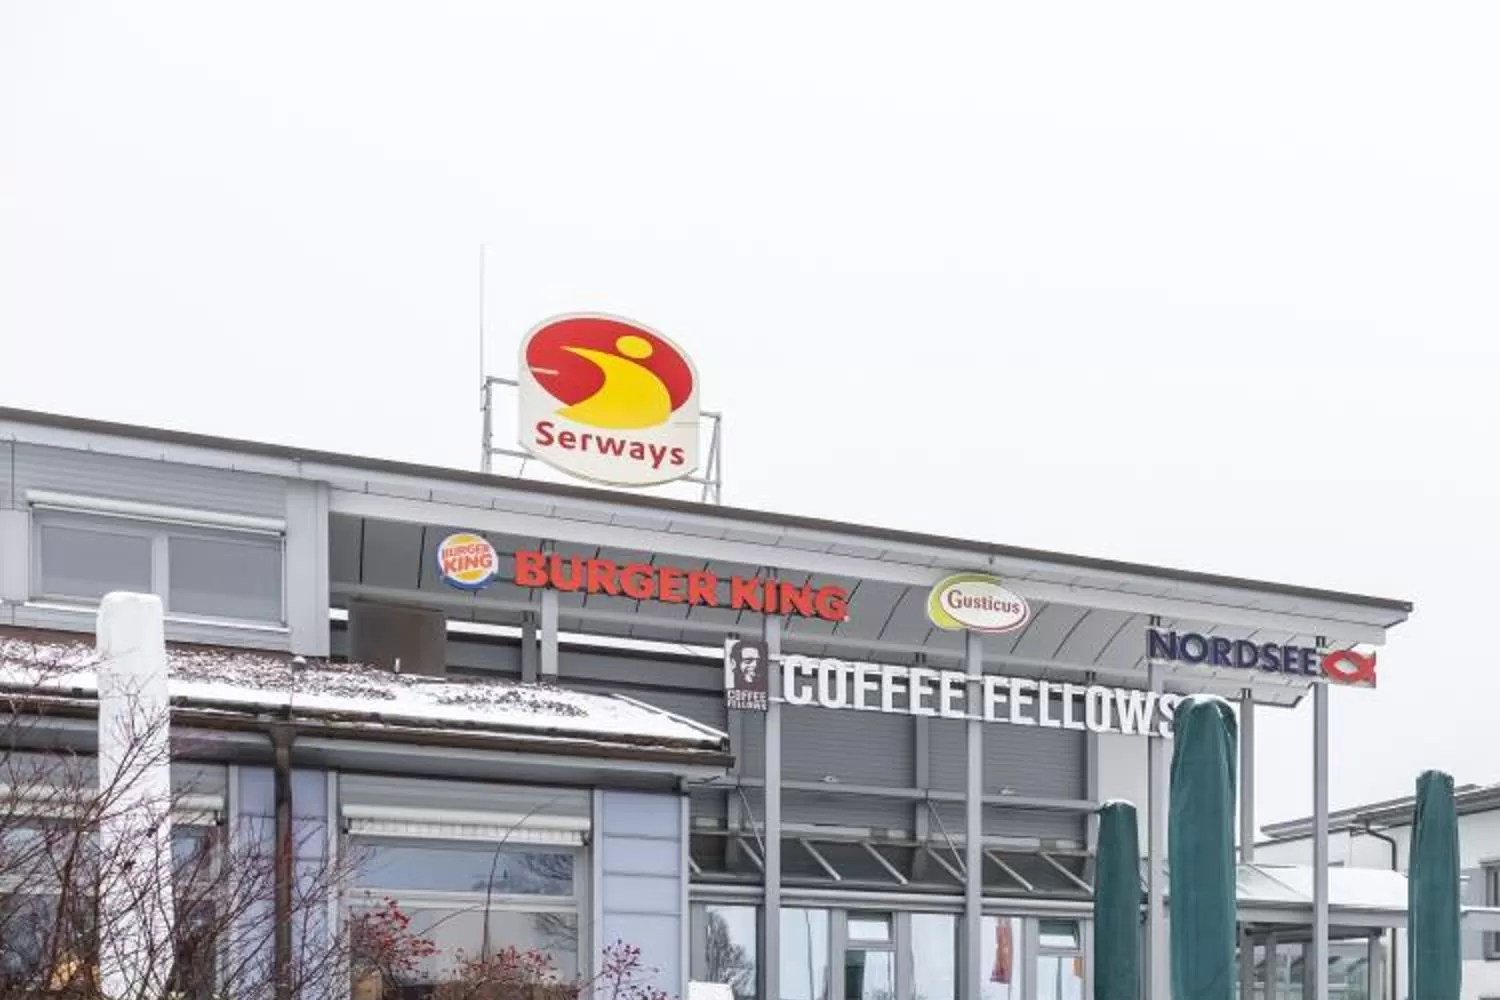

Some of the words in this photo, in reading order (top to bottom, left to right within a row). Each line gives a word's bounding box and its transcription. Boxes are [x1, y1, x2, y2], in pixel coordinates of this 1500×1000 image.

[535, 421, 685, 469] Serways
[441, 543, 492, 558] BURGER
[443, 552, 493, 575] KING
[513, 551, 718, 607] BURGER
[730, 576, 848, 621] KING
[947, 589, 1021, 614] Gusticus
[1146, 628, 1317, 676] NORDSEE
[727, 689, 767, 701] COFFEE
[727, 699, 767, 710] FELLOWS
[782, 654, 967, 719] COFFEE
[984, 675, 1176, 739] FELLOWS
